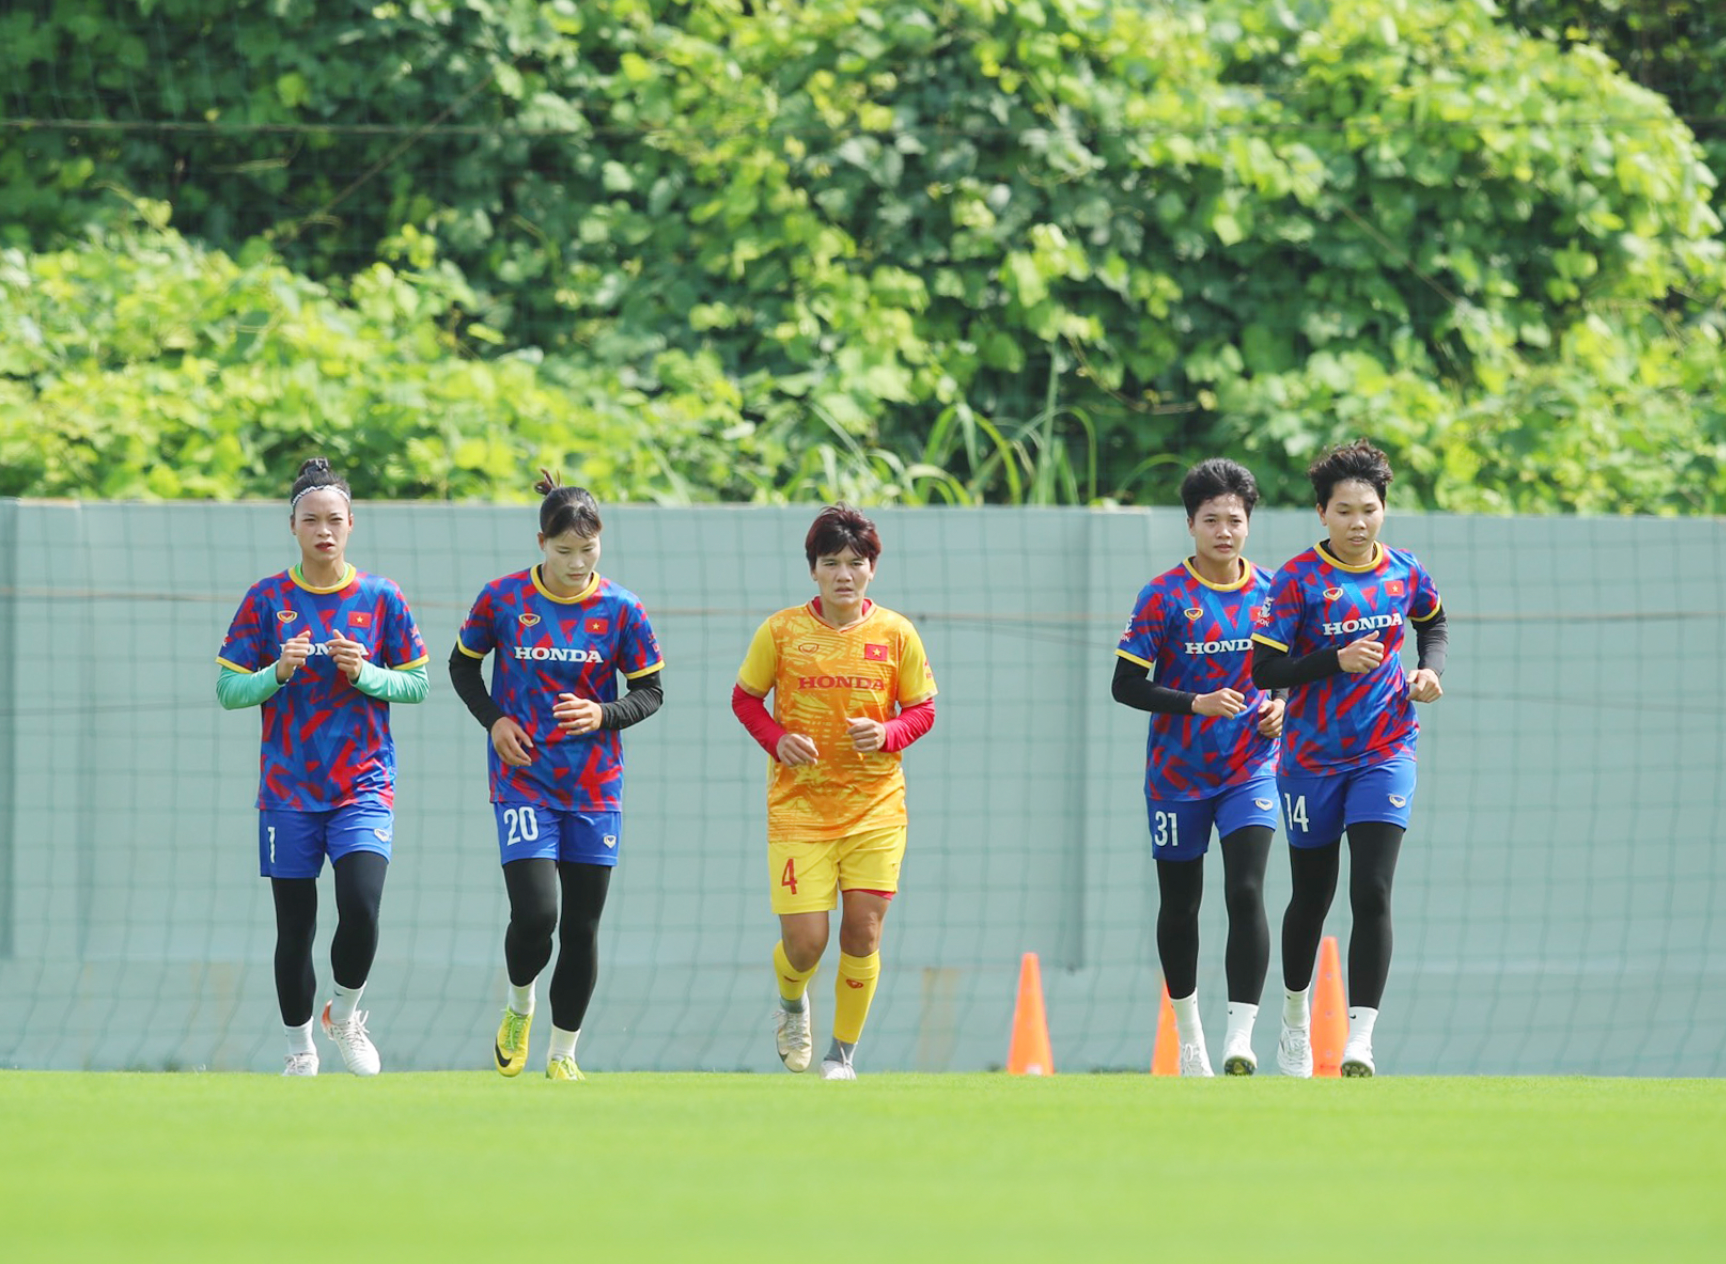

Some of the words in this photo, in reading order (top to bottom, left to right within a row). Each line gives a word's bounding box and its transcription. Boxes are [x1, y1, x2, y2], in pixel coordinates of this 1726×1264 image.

[1322, 613, 1403, 635] HONDA
[515, 646, 604, 664] HONDA
[1185, 638, 1255, 654] HOND
[798, 675, 886, 691] HONDA
[503, 806, 539, 846] 20
[1154, 811, 1179, 846] 31
[1284, 793, 1309, 832] 14
[267, 826, 276, 864] 1
[781, 858, 798, 895] 4
